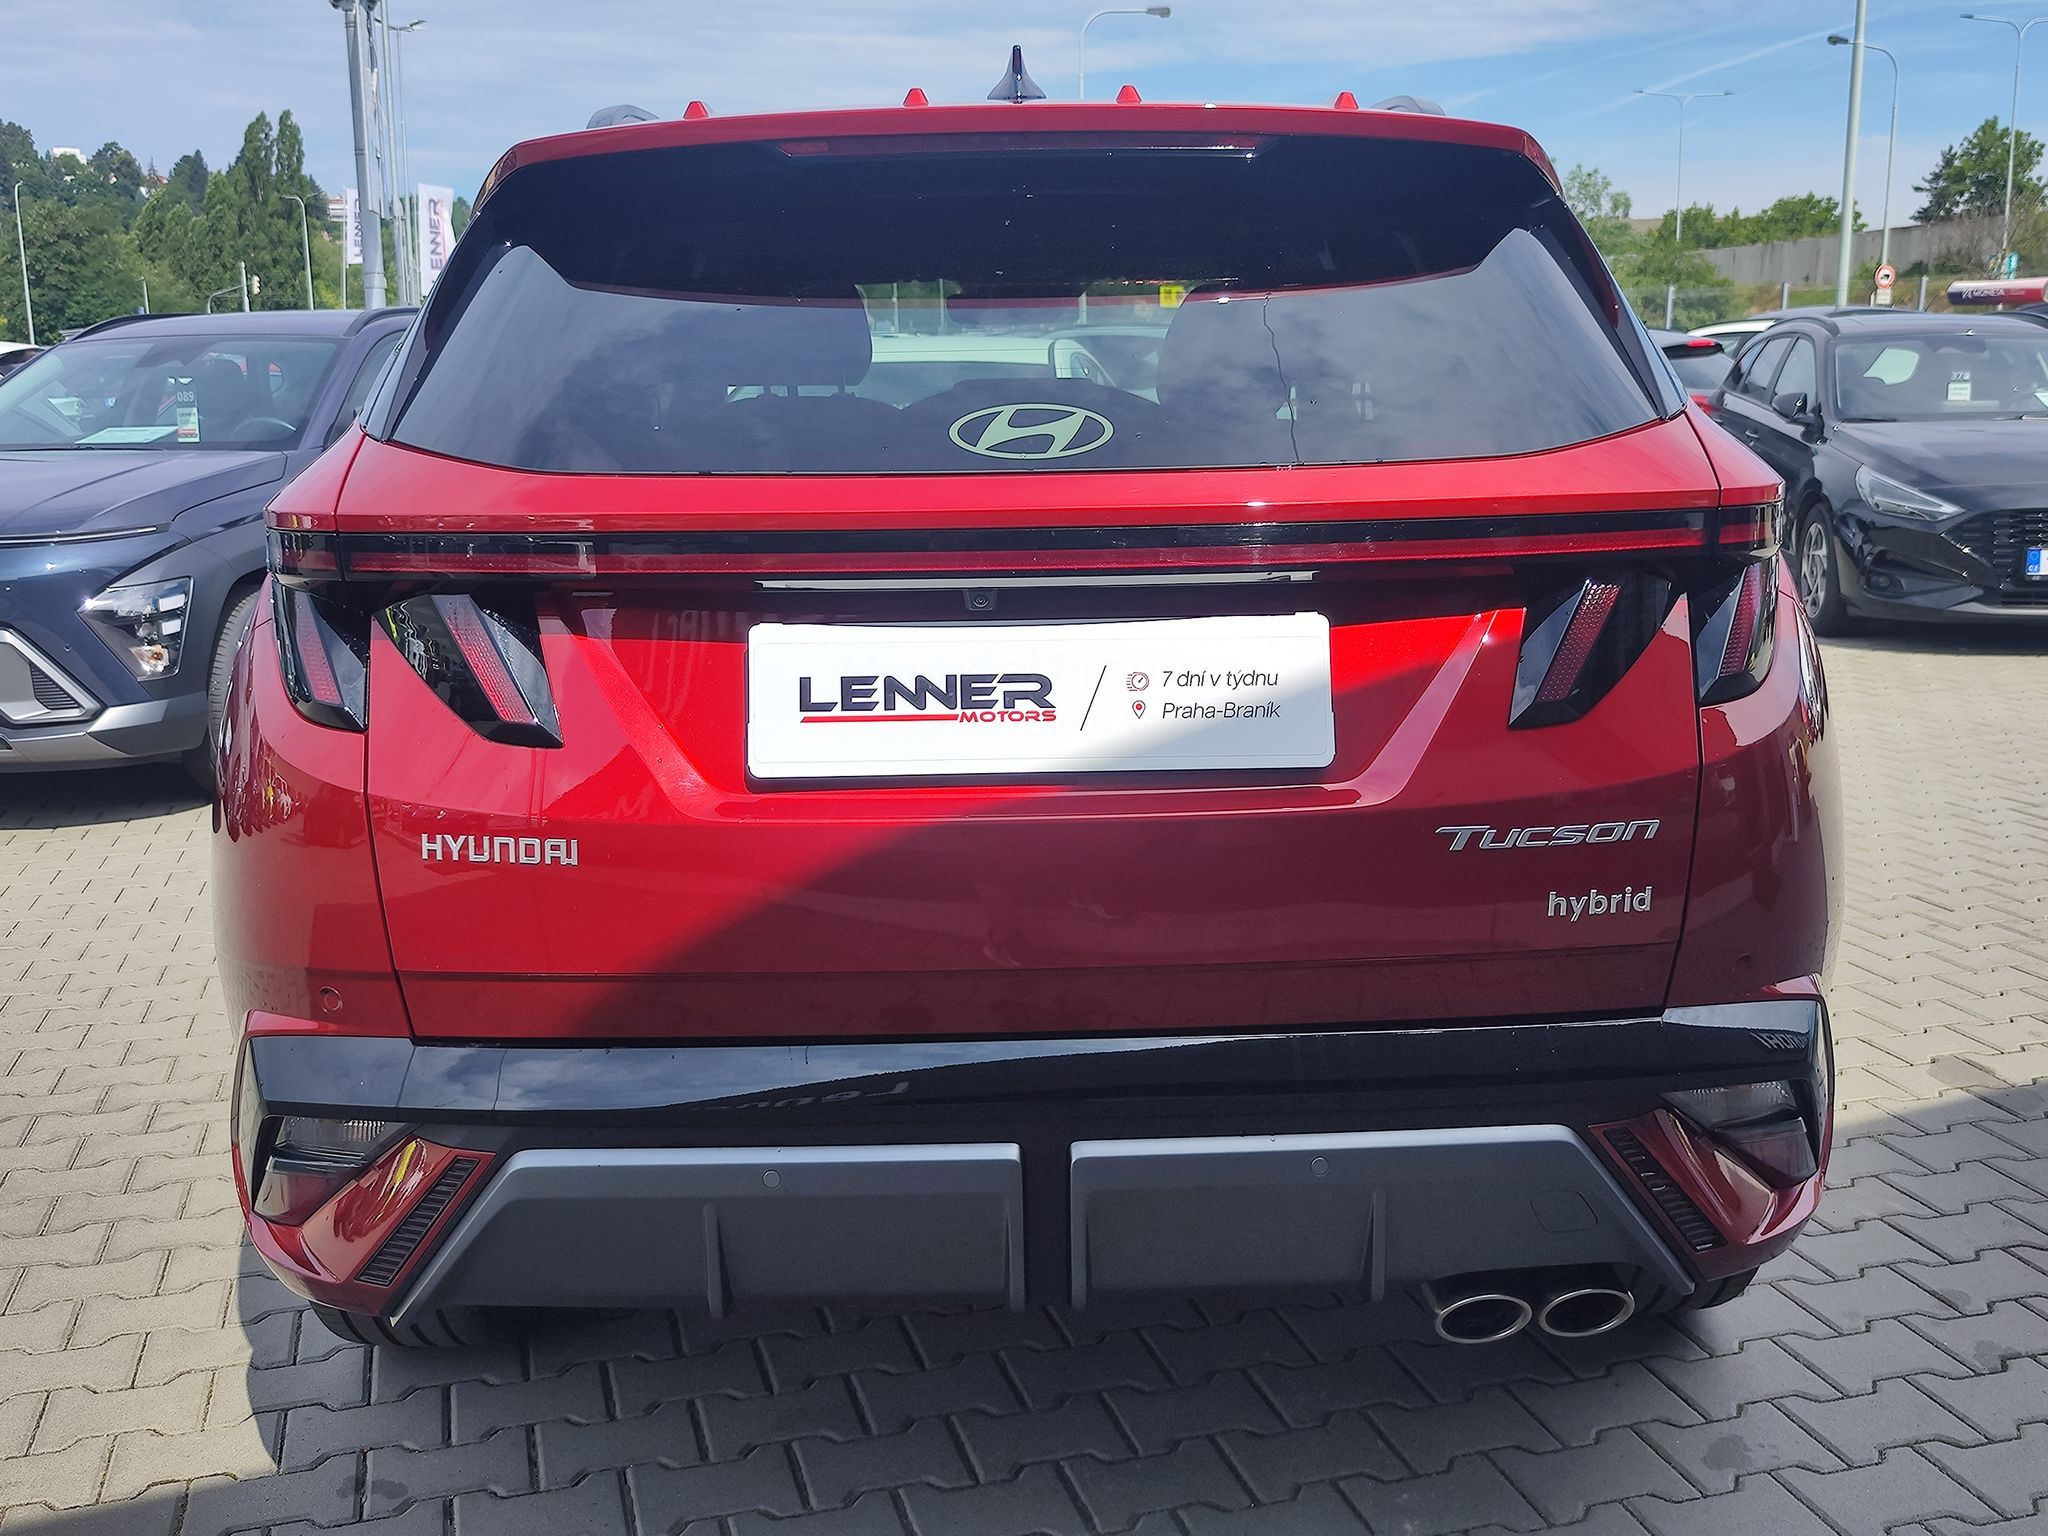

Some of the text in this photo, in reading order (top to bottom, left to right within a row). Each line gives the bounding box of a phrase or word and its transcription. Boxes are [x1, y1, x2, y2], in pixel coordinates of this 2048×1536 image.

[799, 673, 1056, 712] LENNER
[1162, 670, 1279, 690] 7 dní v týdnu
[959, 710, 1057, 723] MOTORS
[1162, 701, 1282, 719] Praha-Braník
[420, 833, 579, 866] HYUNDAI
[1547, 886, 1653, 922] hybrid
